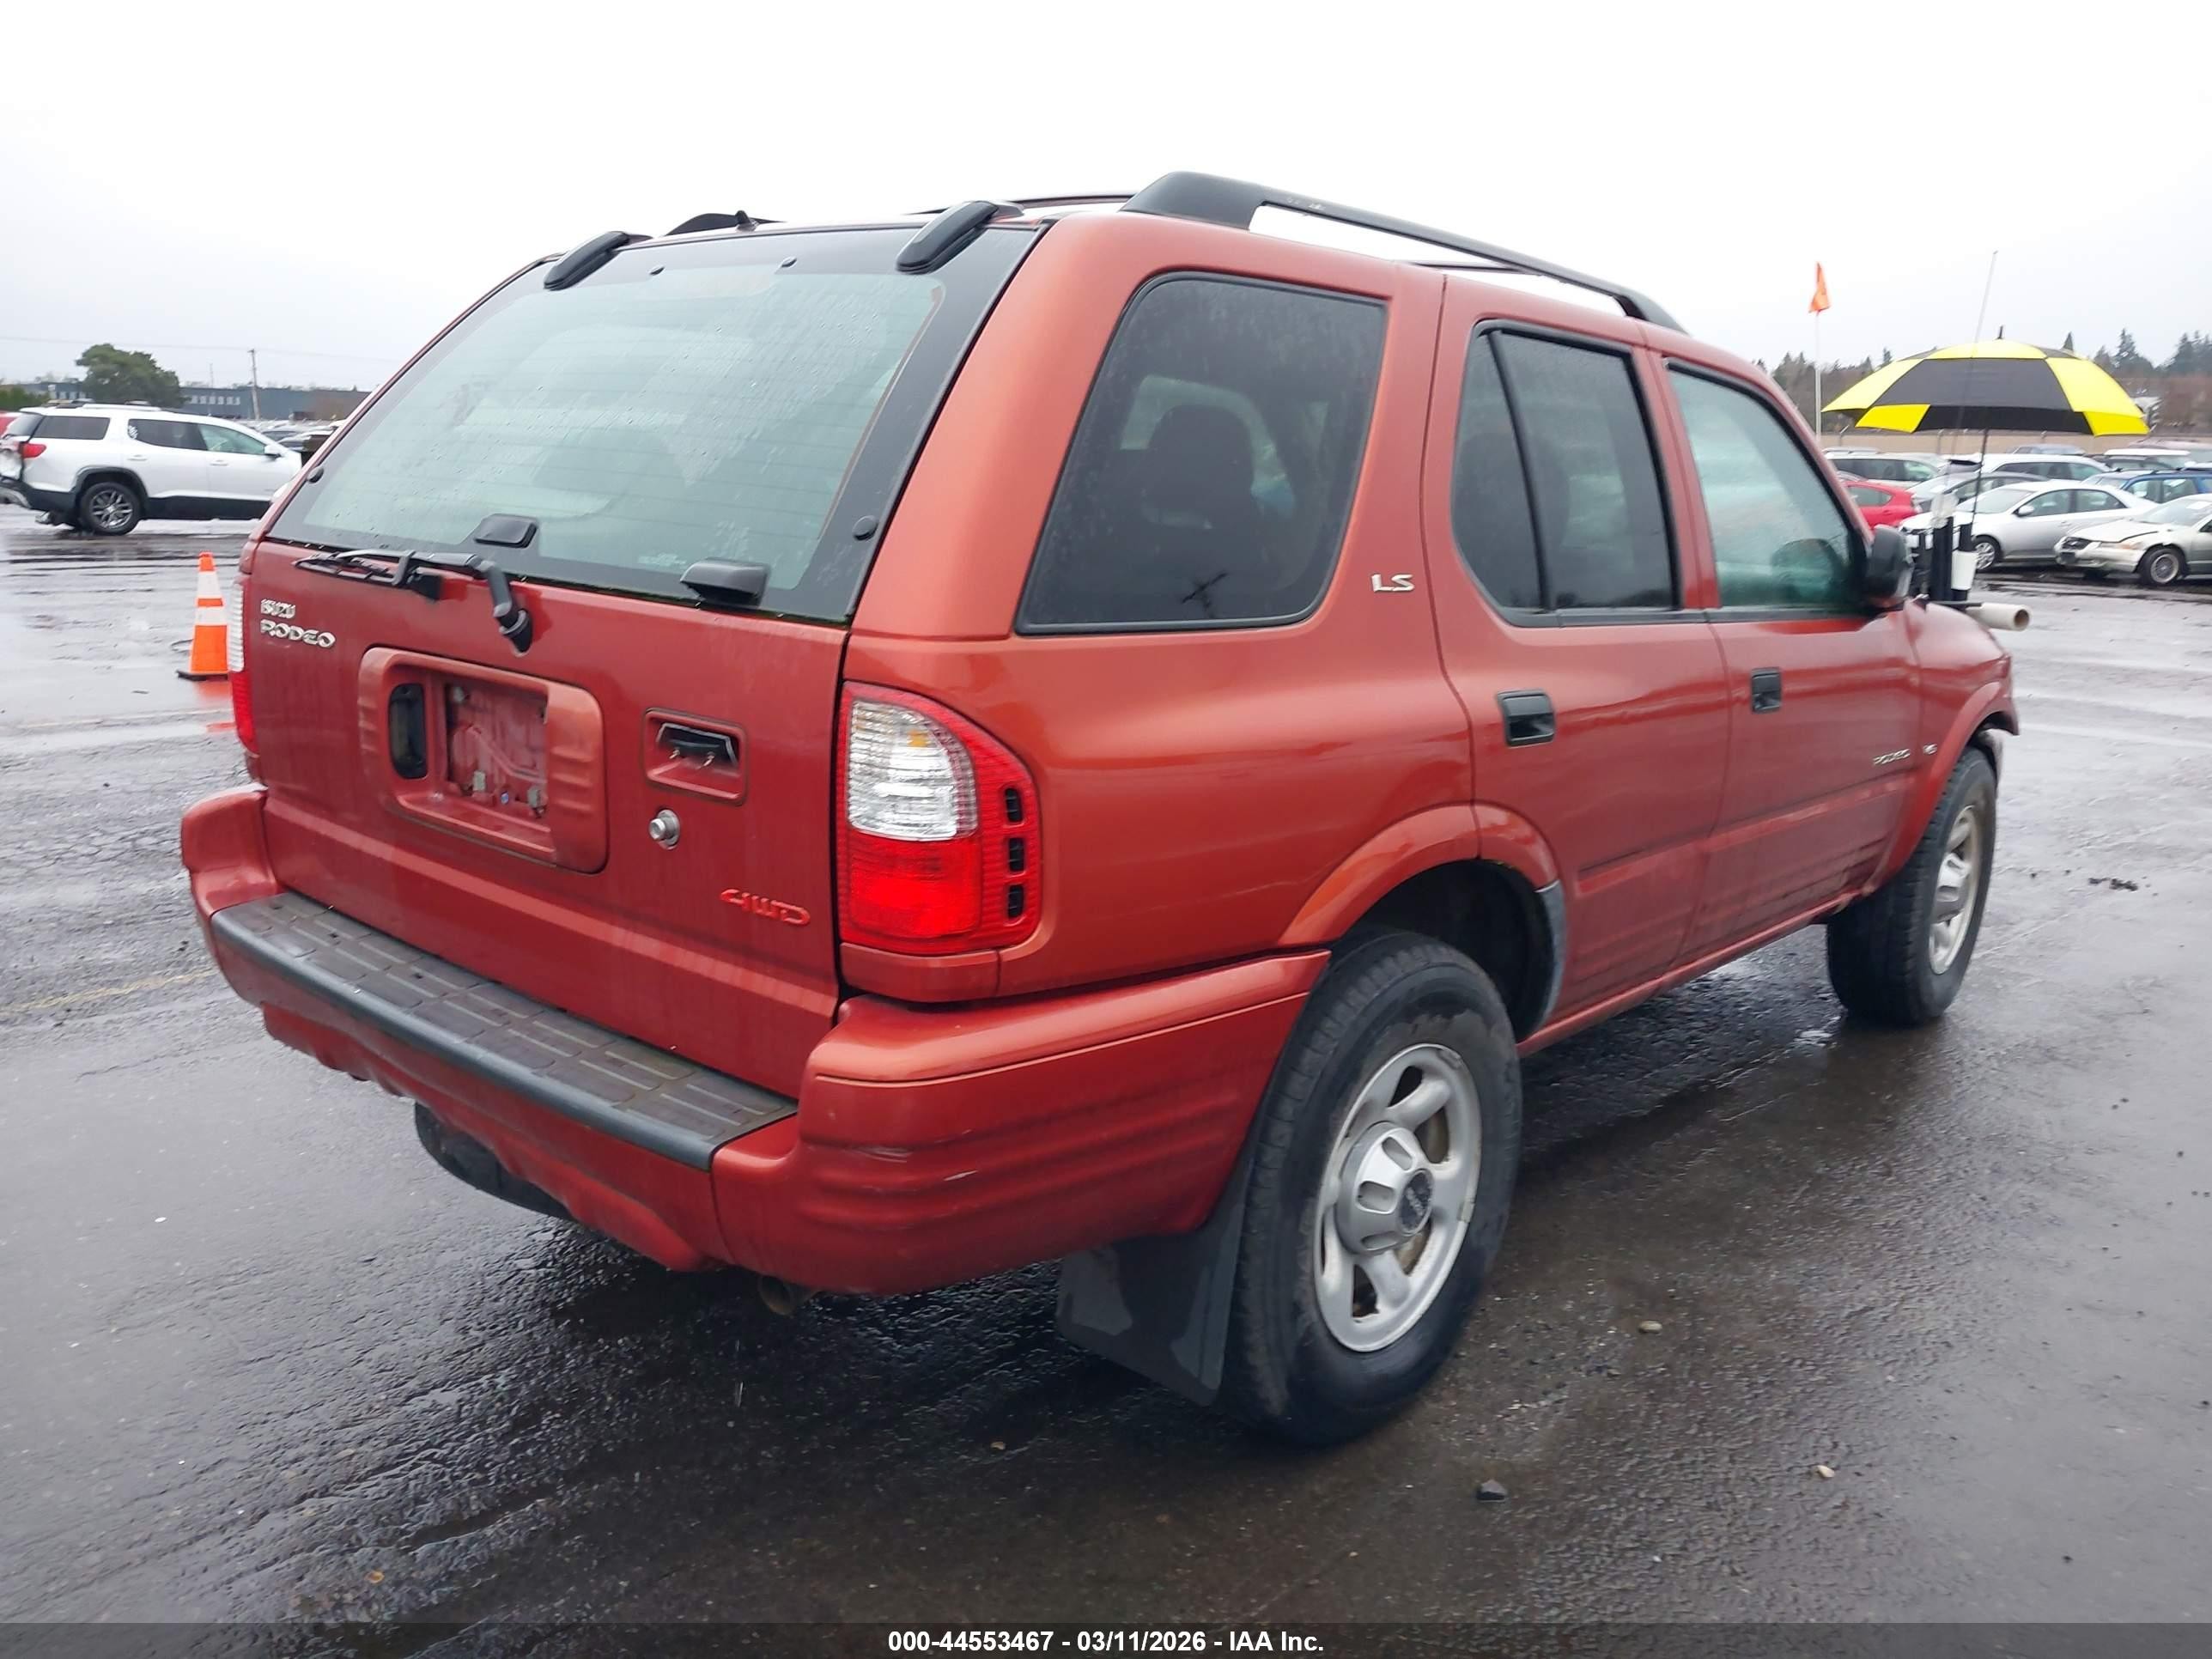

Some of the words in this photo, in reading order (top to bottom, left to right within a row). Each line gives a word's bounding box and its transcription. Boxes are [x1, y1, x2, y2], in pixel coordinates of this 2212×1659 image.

[1370, 573, 1415, 592] LS
[259, 618, 336, 648] RODEO
[719, 888, 811, 925] 4WD
